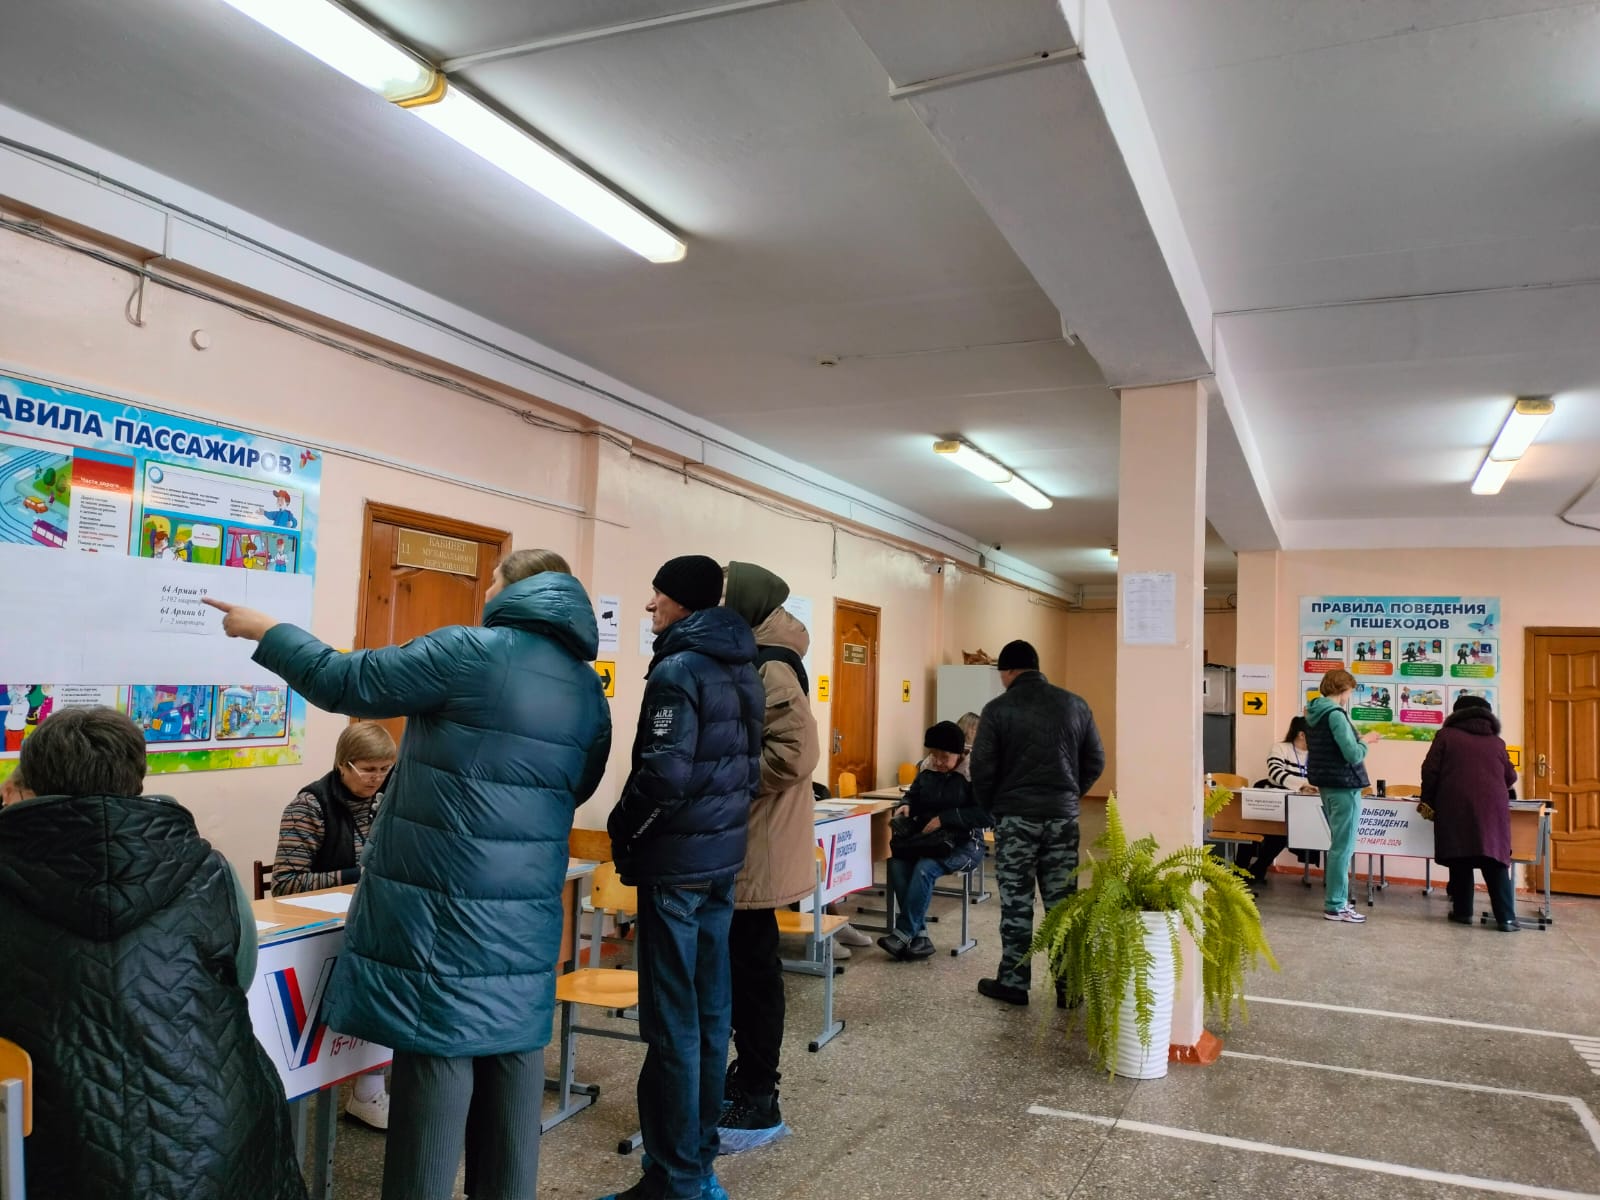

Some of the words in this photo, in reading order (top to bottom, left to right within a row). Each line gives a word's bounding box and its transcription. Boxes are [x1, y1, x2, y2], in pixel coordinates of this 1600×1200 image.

[0, 394, 103, 438] АВИЛА
[114, 419, 292, 475] ПАССАЖИРОВ
[162, 585, 171, 593] 64
[173, 586, 198, 596] Армии
[160, 607, 170, 615] 64
[171, 608, 196, 617] Армии
[1311, 602, 1385, 614] ПРАВИЛА
[1390, 603, 1486, 616] ПОВЕДЕНИЯ
[1350, 617, 1450, 631] ПЕШЕХОДОВ
[1361, 807, 1398, 818] ВЫБОРЫ
[1359, 817, 1409, 829] ПРЕЗИДЕНТА
[1357, 827, 1387, 837] ОССИИ
[1367, 837, 1387, 846] МАРТА
